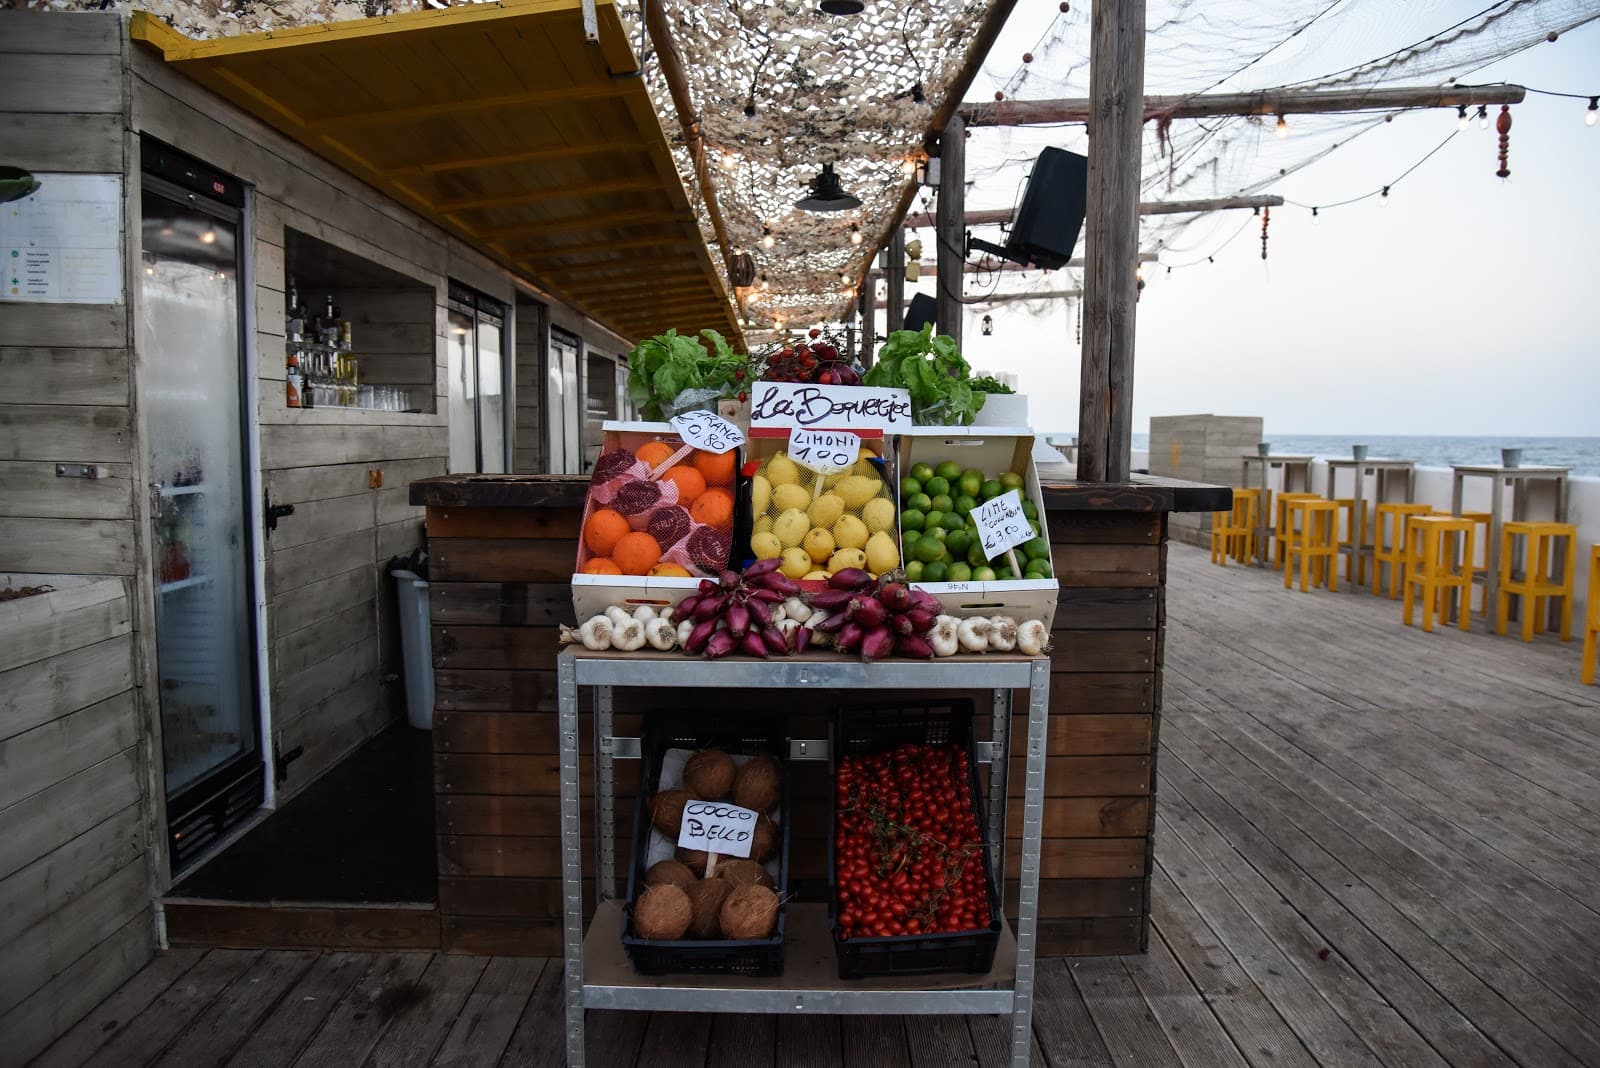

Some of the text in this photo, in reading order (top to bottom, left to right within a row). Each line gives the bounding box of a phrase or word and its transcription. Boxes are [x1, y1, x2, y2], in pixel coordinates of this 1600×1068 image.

[751, 386, 795, 420] La
[981, 500, 1008, 522] LIME
[687, 803, 752, 820] COCCO
[687, 818, 750, 842] BELLO
